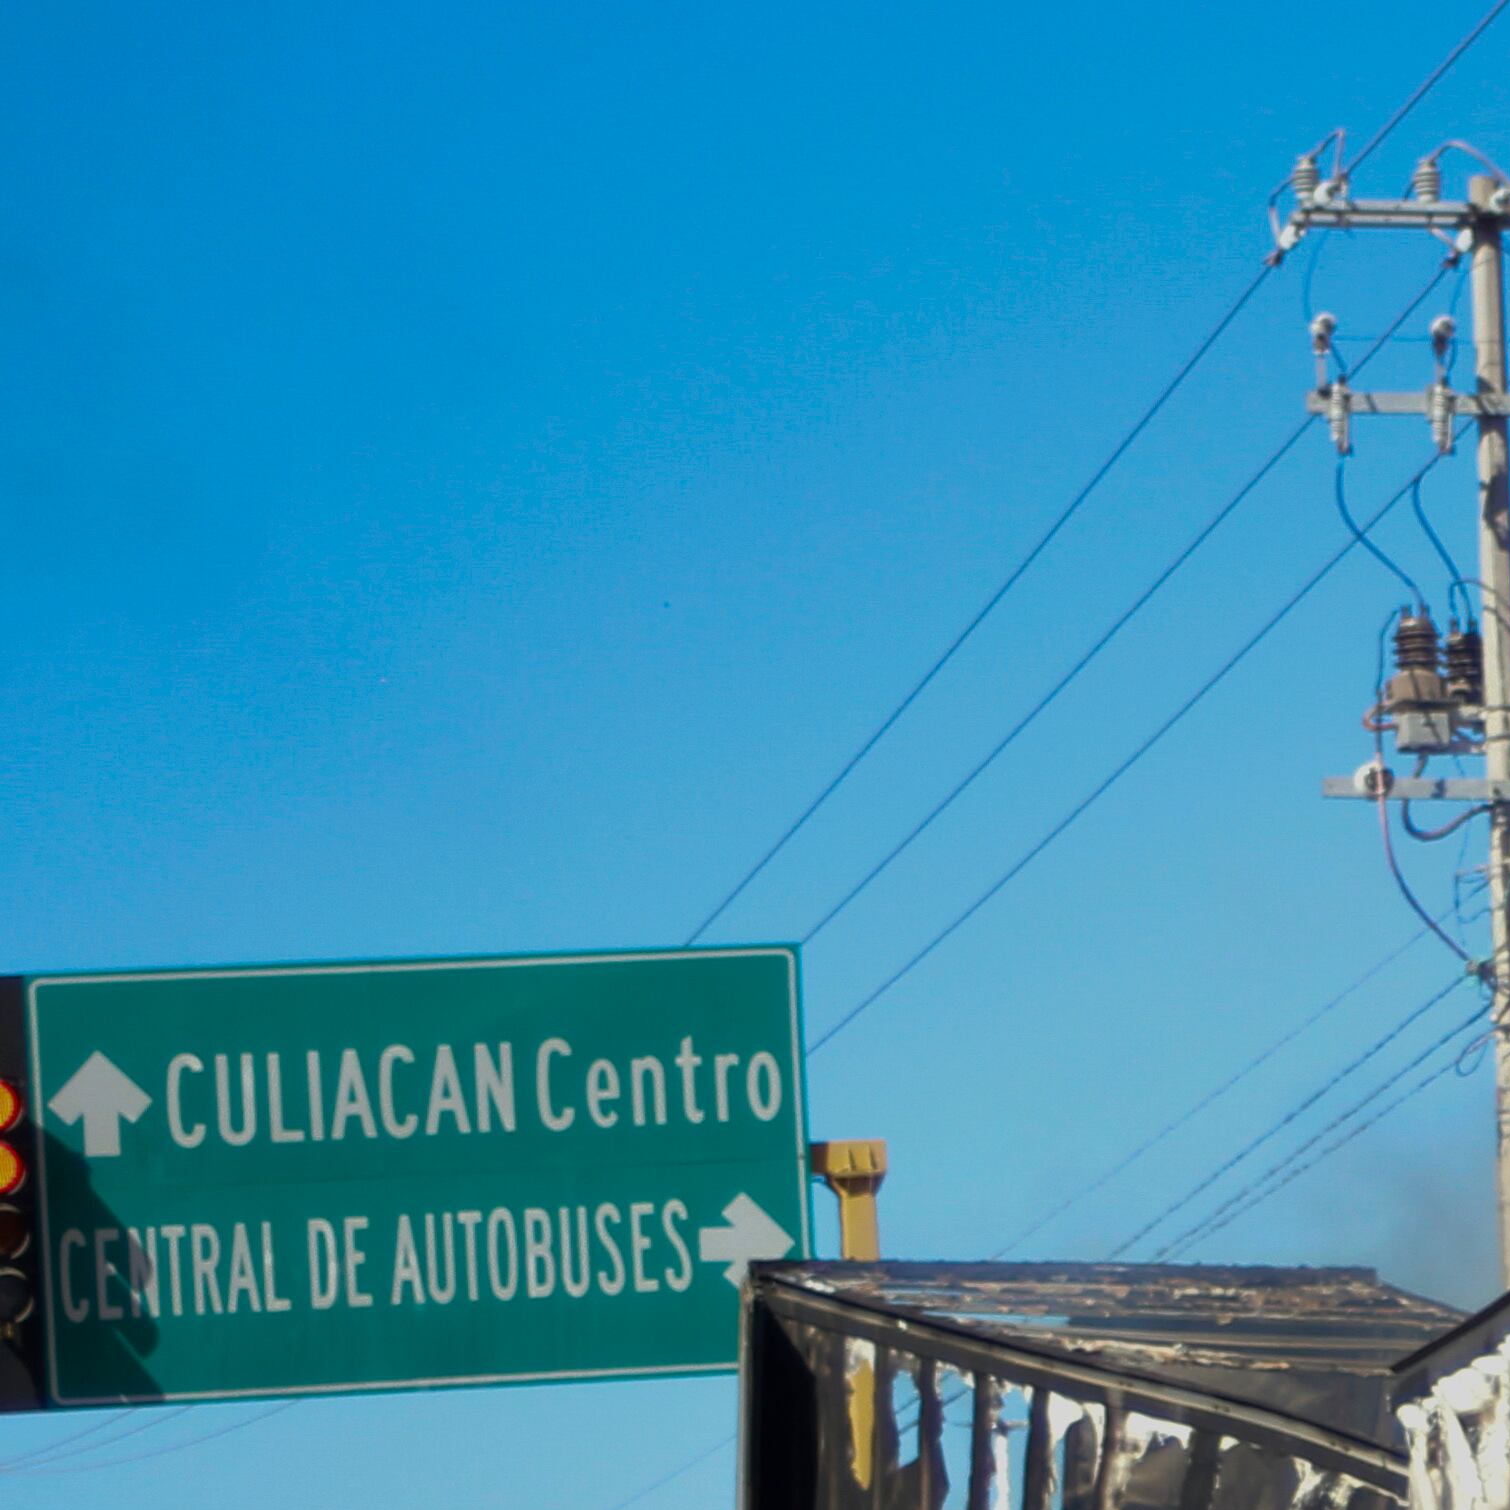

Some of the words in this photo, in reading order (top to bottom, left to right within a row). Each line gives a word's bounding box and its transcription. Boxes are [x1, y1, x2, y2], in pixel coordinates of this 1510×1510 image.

[167, 1042, 516, 1148] CULIACAN
[537, 1036, 782, 1131] Centro
[60, 1220, 292, 1323] CENTRAL
[310, 1217, 373, 1309] DE
[392, 1198, 693, 1306] AUTOBUSES
